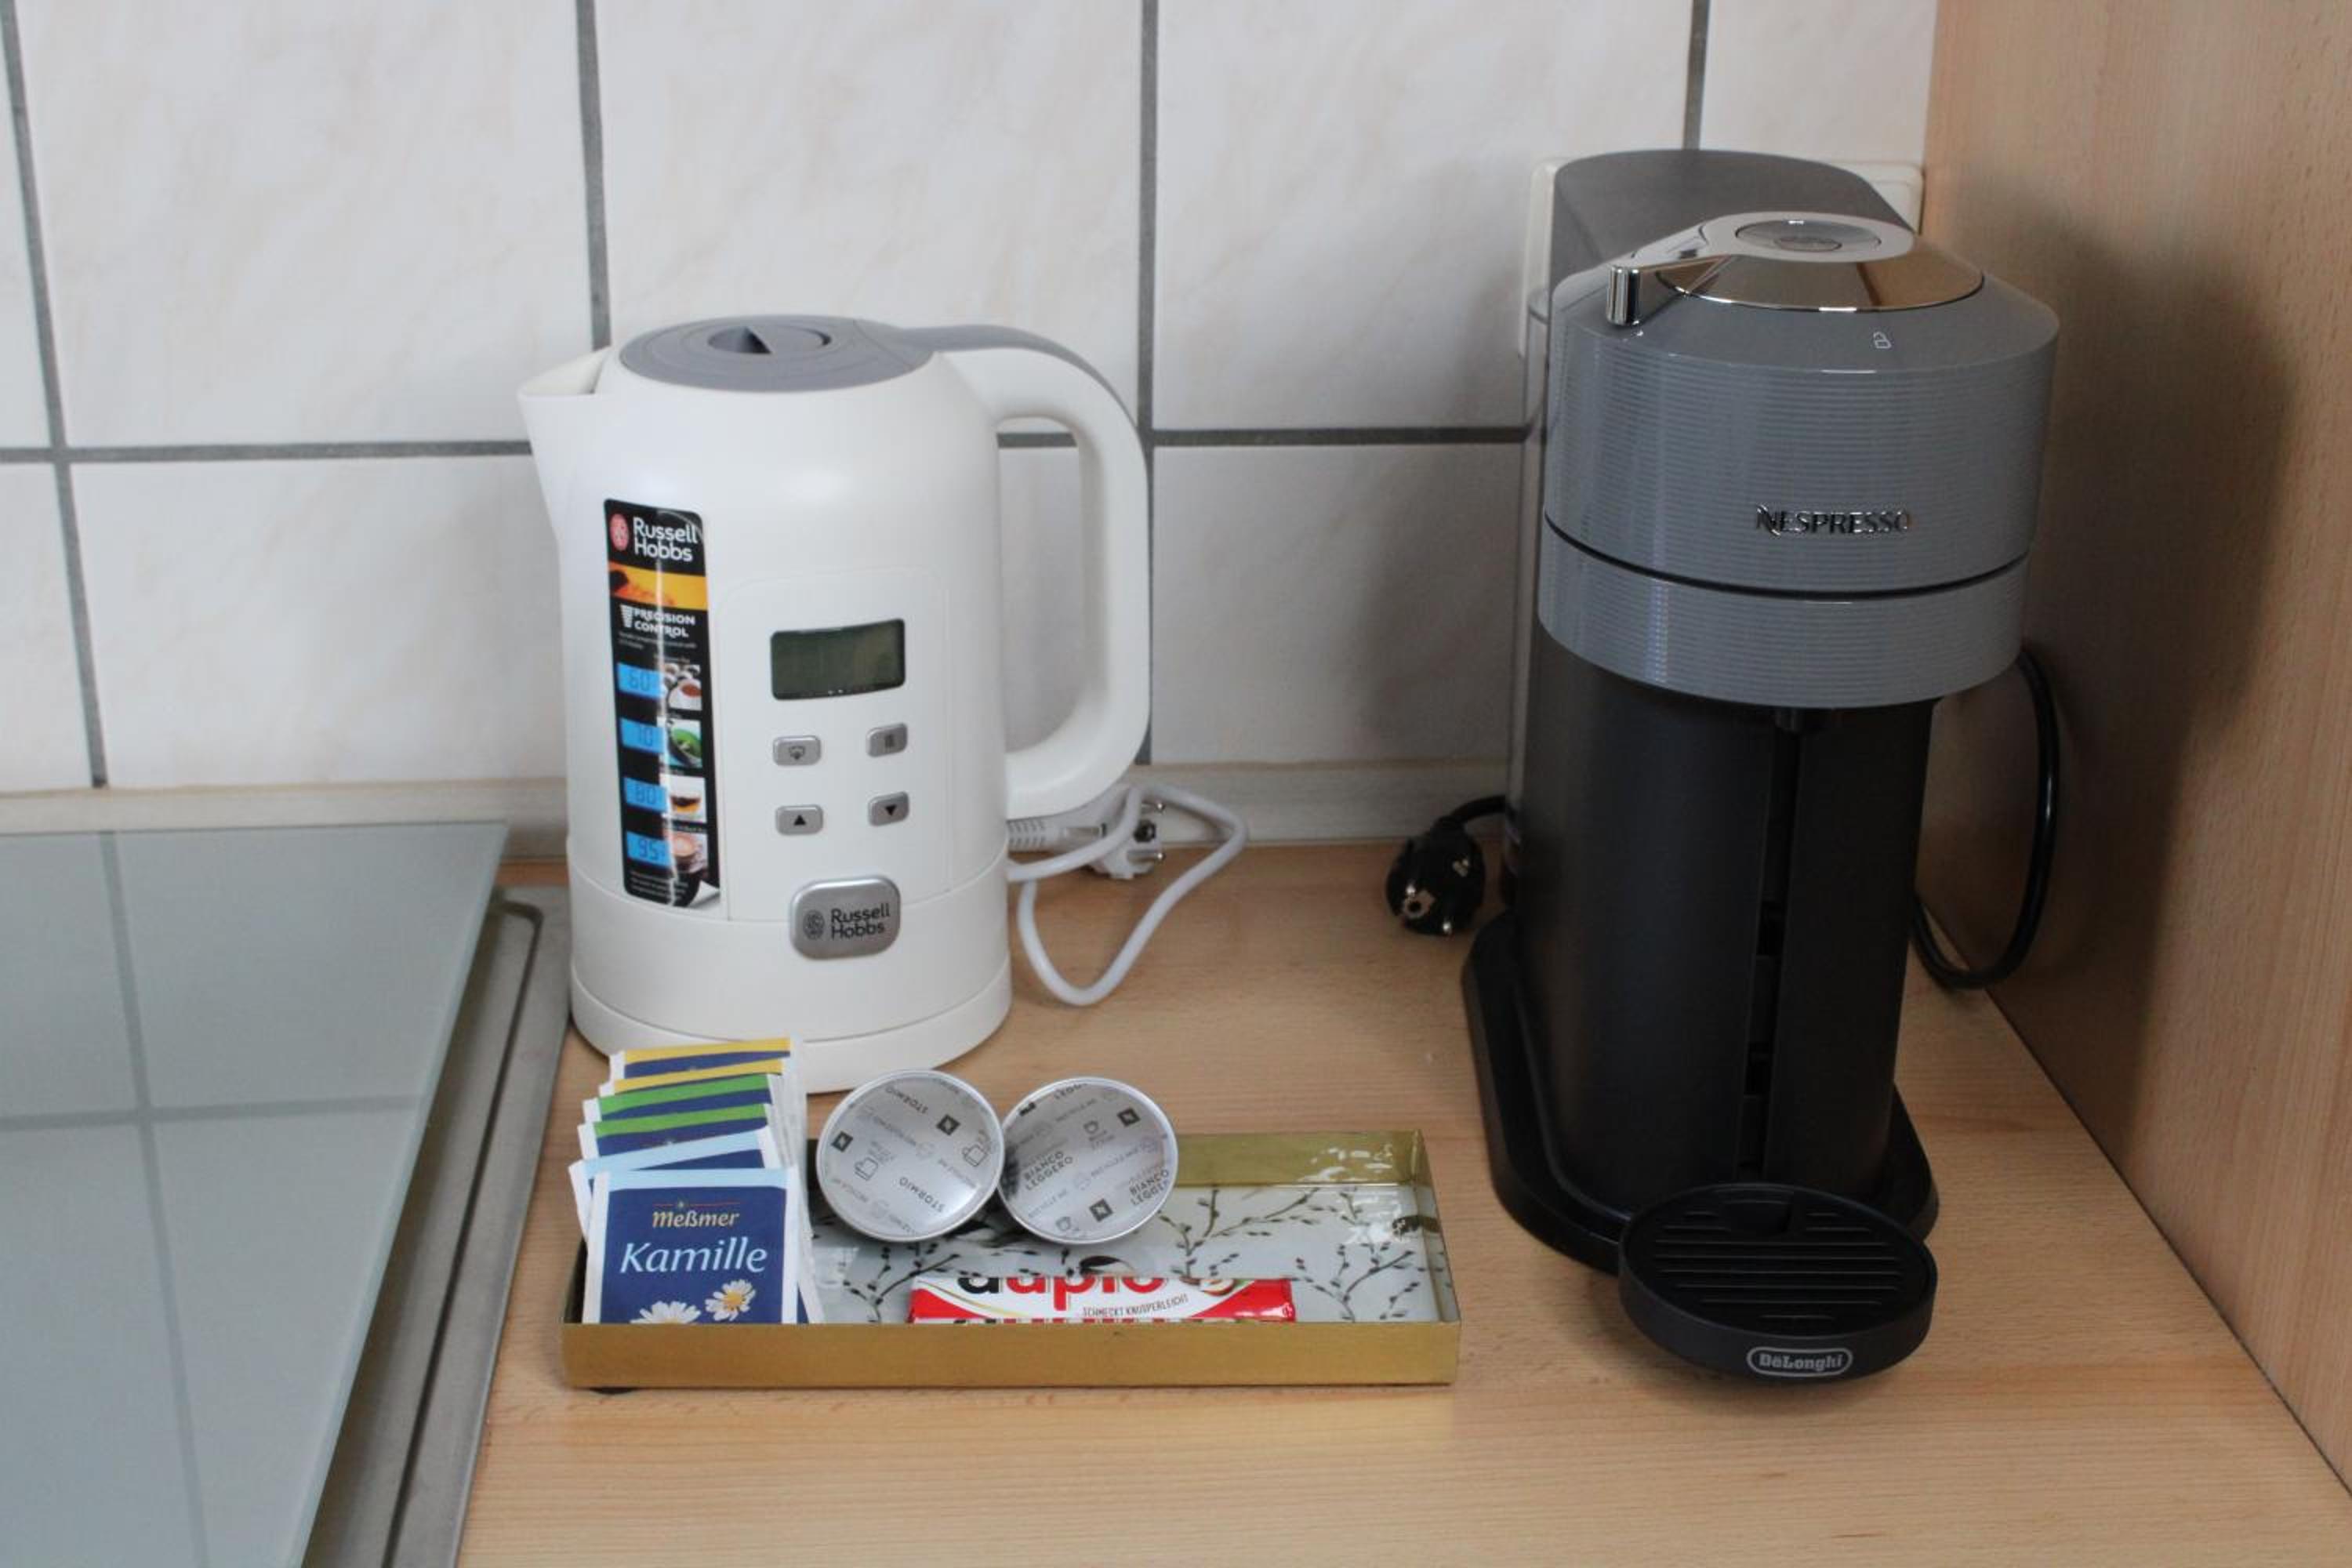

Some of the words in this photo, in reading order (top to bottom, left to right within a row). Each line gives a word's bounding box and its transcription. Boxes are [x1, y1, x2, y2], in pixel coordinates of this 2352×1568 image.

[632, 517, 699, 544] Russell
[1755, 504, 1912, 536] NESPRESSO
[633, 537, 694, 562] Hobbs
[633, 620, 689, 639] CONTROL
[830, 902, 891, 924] Russell
[830, 922, 885, 940] Hobbs
[1025, 1156, 1073, 1191] LEGGERO
[899, 1177, 945, 1213] STORMIO
[652, 1210, 740, 1229] Meßmer
[619, 1236, 768, 1274] Kamille
